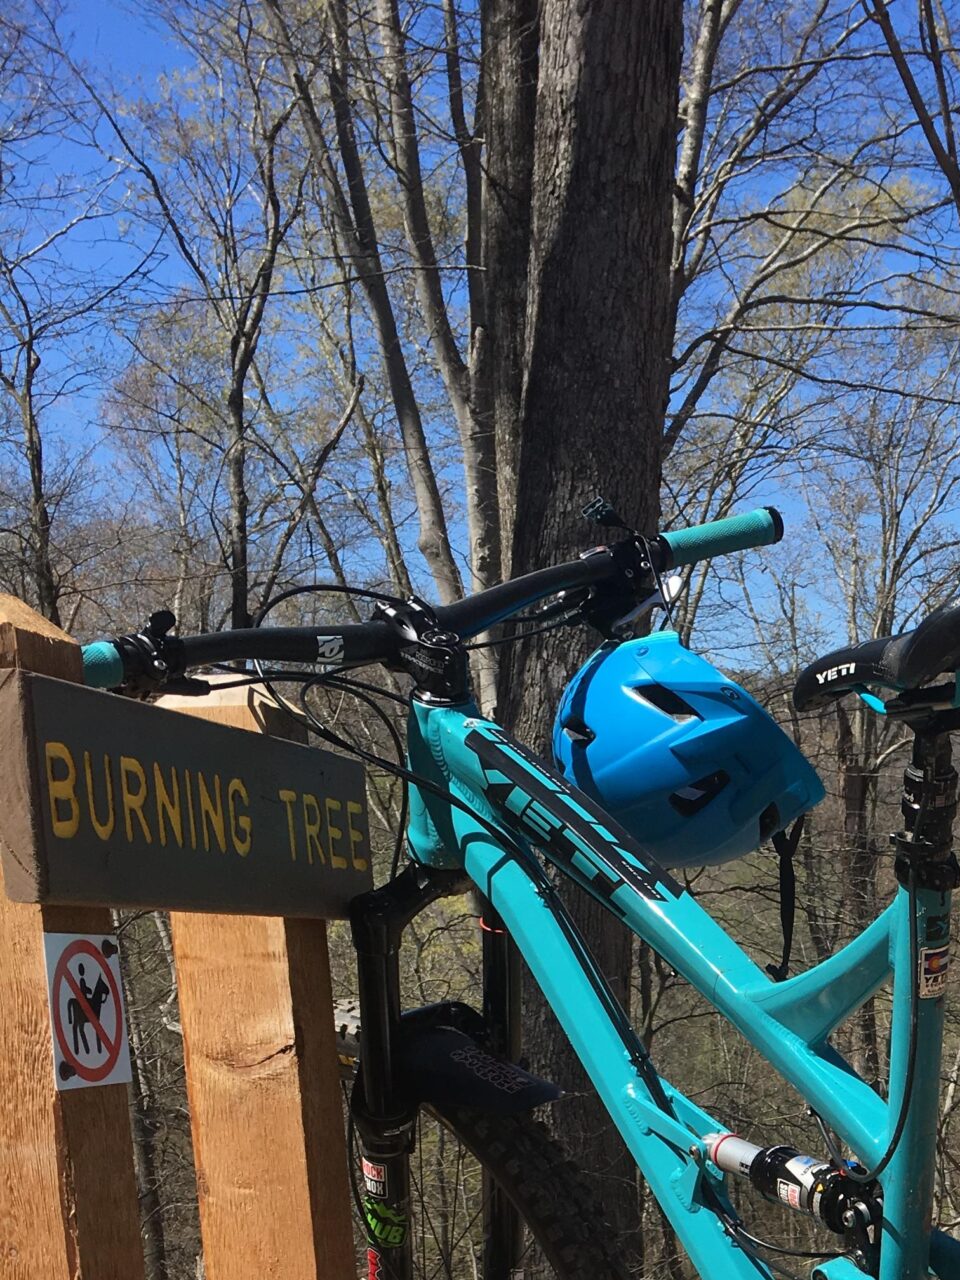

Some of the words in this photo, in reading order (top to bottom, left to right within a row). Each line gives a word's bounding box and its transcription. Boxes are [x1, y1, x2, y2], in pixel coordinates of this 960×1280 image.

[815, 662, 857, 685] YETI
[45, 741, 252, 858] BURNING
[279, 789, 368, 872] TREE
[466, 765, 645, 918] YETI
